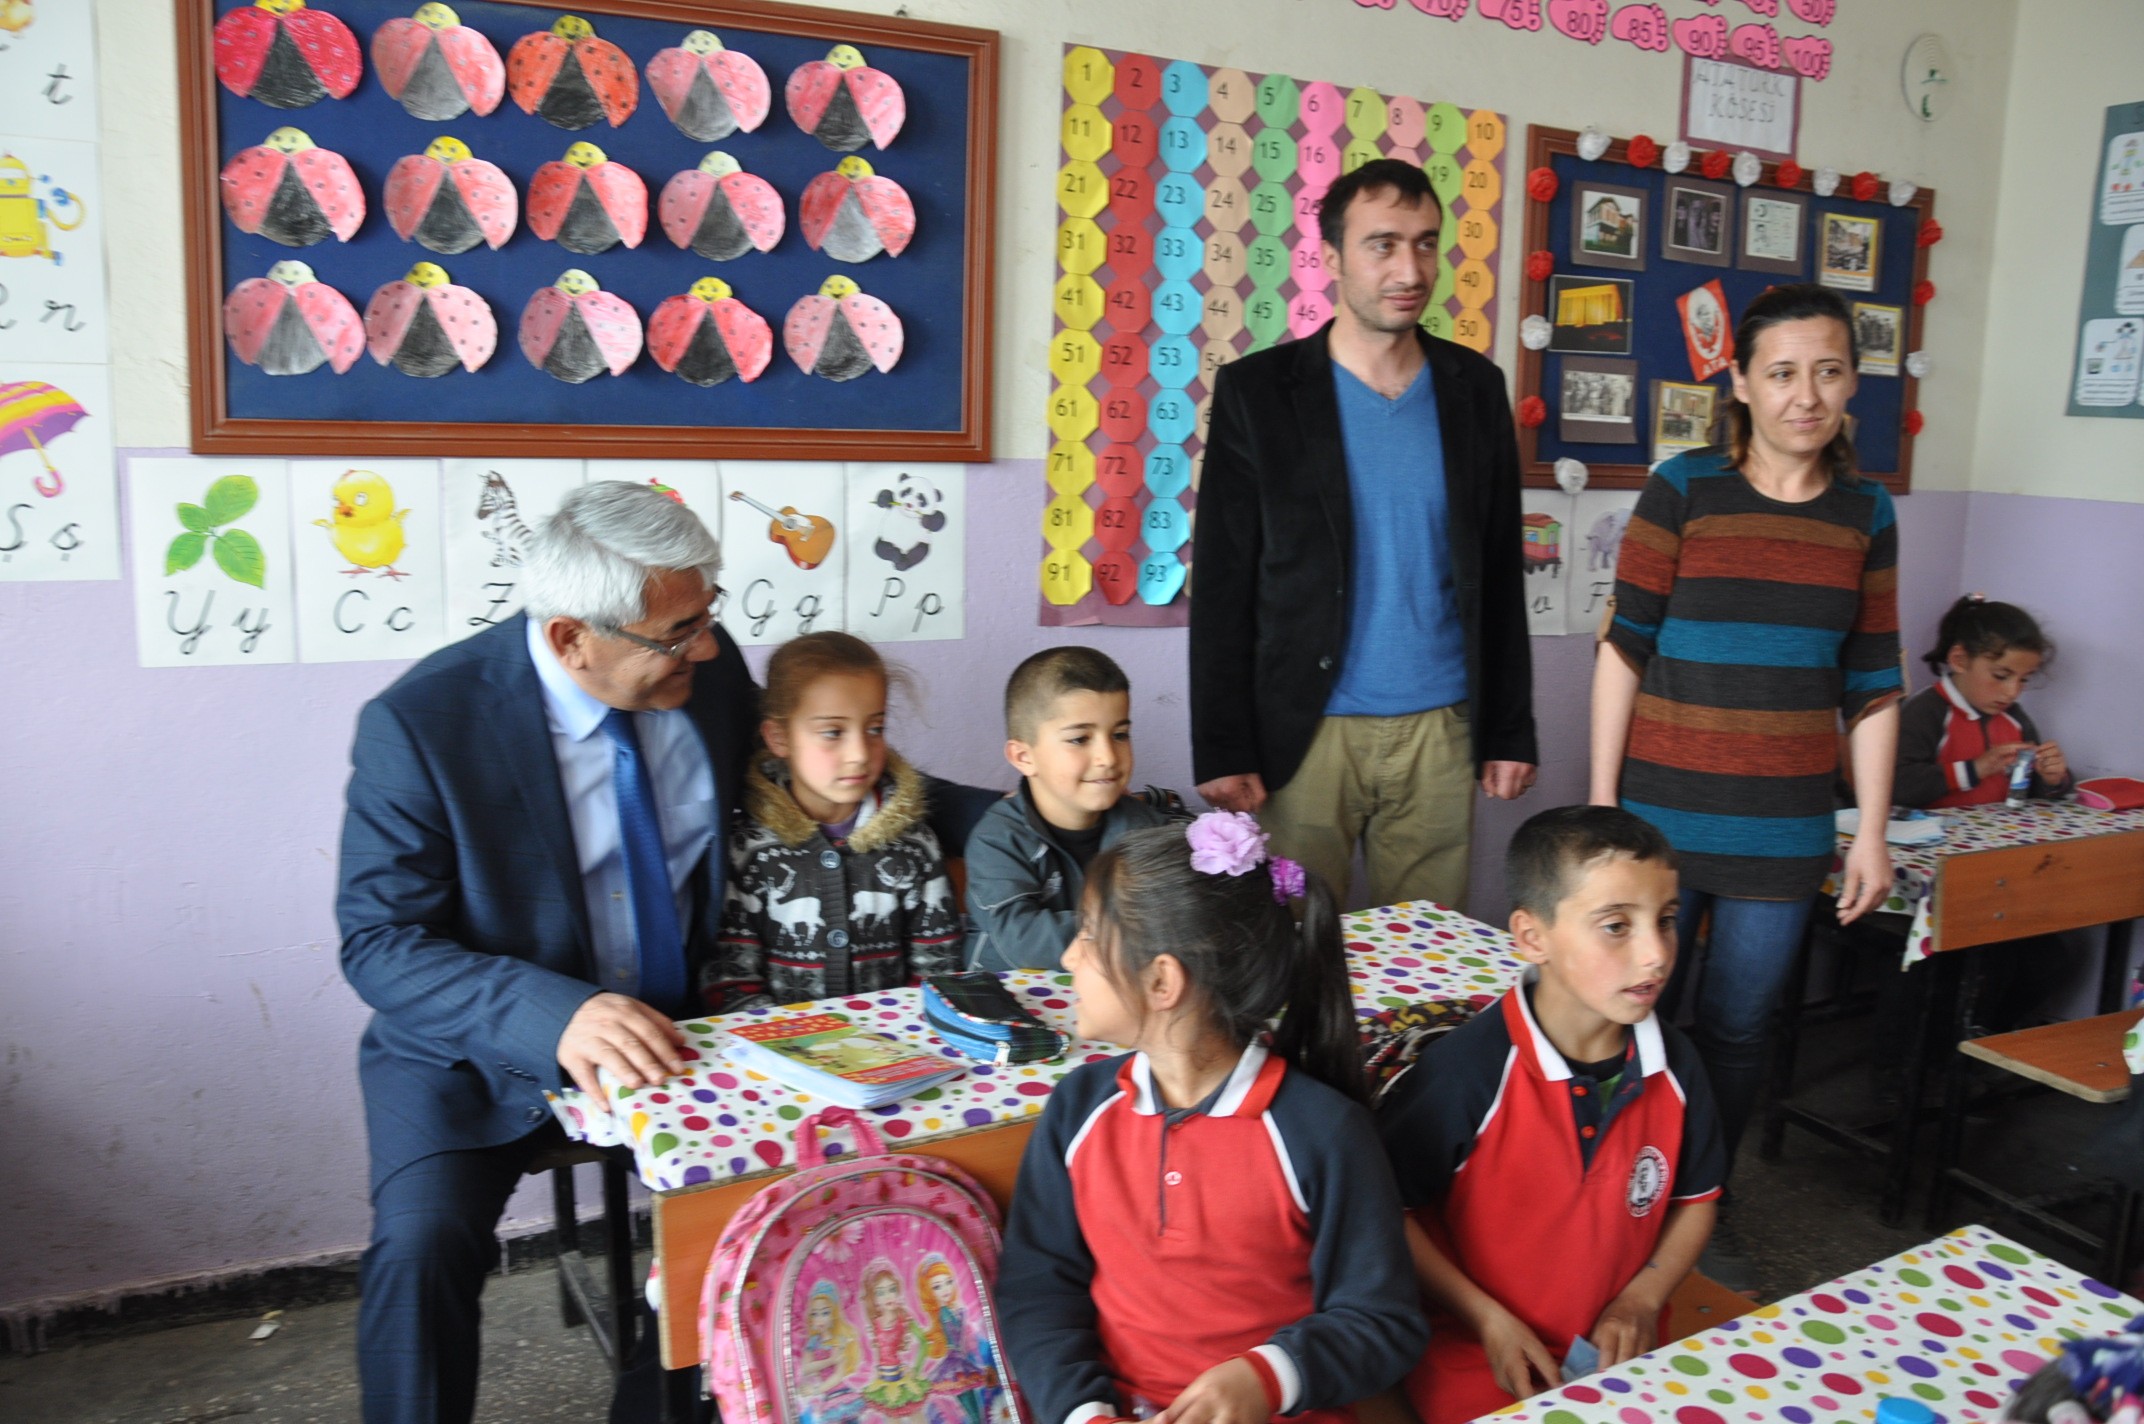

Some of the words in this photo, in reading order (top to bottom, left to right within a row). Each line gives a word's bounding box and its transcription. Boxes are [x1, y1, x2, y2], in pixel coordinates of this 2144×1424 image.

[1566, 10, 1592, 35] 80
[1628, 18, 1651, 43] 85
[1689, 29, 1712, 52] 90
[1743, 37, 1765, 61] 95
[1793, 49, 1819, 77] 100
[41, 62, 74, 105] t
[1082, 62, 1091, 82] 1
[1130, 67, 1143, 88] 2
[1168, 73, 1182, 93] 3
[1216, 81, 1229, 99] 4
[1263, 86, 1275, 106] 5
[1307, 94, 1320, 112] 6
[1352, 99, 1363, 118] 7
[1391, 107, 1403, 126] 8
[1431, 114, 1443, 132] 9
[1475, 122, 1495, 140] 10
[1069, 117, 1091, 137] 11
[1121, 125, 1142, 144] 12
[1167, 130, 1189, 149] 13
[1216, 136, 1237, 155] 14
[1259, 141, 1281, 160] 15
[1304, 146, 1326, 164] 16
[1431, 166, 1450, 183] 19
[1468, 171, 1488, 189] 20
[1064, 173, 1086, 194] 21
[1114, 178, 1138, 199] 22
[1162, 185, 1186, 205] 23
[1210, 189, 1234, 209] 24
[1255, 193, 1277, 213] 25
[1463, 220, 1484, 239] 30
[1063, 230, 1085, 250] 31
[1114, 234, 1137, 255] 32
[1161, 237, 1185, 258] 33
[1211, 243, 1232, 263] 34
[1254, 247, 1275, 267] 35
[1297, 250, 1320, 268] 36
[1461, 271, 1480, 288] 40
[1061, 288, 1084, 306] 41
[1112, 290, 1135, 309] 42
[1160, 293, 1184, 312] 43
[1207, 299, 1229, 317] 44
[1252, 301, 1273, 320] 45
[1296, 304, 1319, 321] 46
[1459, 319, 1479, 337] 50
[1062, 342, 1085, 363] 51
[1109, 344, 1133, 366] 52
[1158, 346, 1182, 367] 53
[1055, 398, 1077, 417] 61
[1106, 400, 1131, 419] 62
[1156, 402, 1180, 421] 63
[1053, 452, 1074, 472] 71
[1104, 456, 1128, 475] 72
[1152, 456, 1174, 476] 73
[1051, 508, 1073, 527] 81
[1102, 509, 1125, 529] 82
[1149, 510, 1172, 530] 83
[1047, 563, 1070, 582] 91
[1099, 563, 1121, 582] 92
[1145, 564, 1168, 583] 93
[164, 590, 216, 655] Y
[232, 607, 272, 654] y
[333, 589, 370, 633] C
[384, 606, 416, 632] c
[741, 578, 778, 637] G
[793, 595, 824, 635] g
[869, 576, 906, 617] P
[911, 592, 946, 633] p
